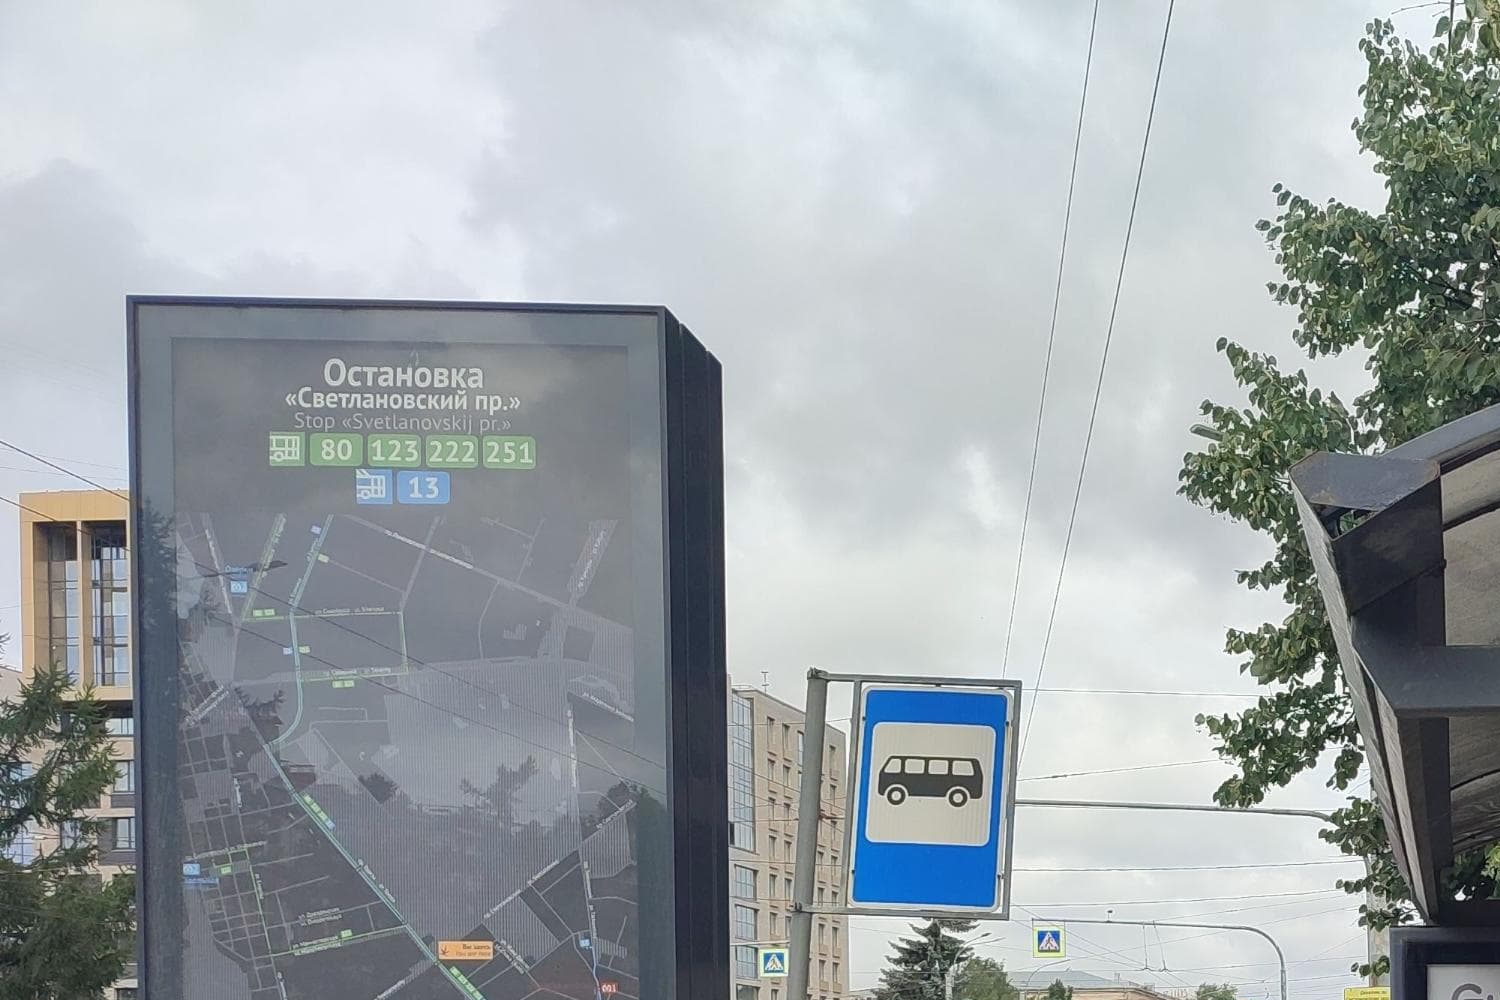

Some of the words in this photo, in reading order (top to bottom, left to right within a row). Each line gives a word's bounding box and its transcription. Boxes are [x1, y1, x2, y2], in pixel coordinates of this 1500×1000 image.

[323, 358, 484, 388] Остановка
[285, 387, 468, 410] «Светлановский
[475, 393, 521, 415] пр.»
[294, 412, 336, 432] Stop
[342, 413, 474, 434] «Svetlanovskij
[479, 417, 512, 434] pr.»
[321, 439, 353, 461] 80
[371, 440, 419, 462] 123
[429, 440, 476, 463] 222
[486, 441, 534, 464] 251
[408, 476, 440, 499] 13
